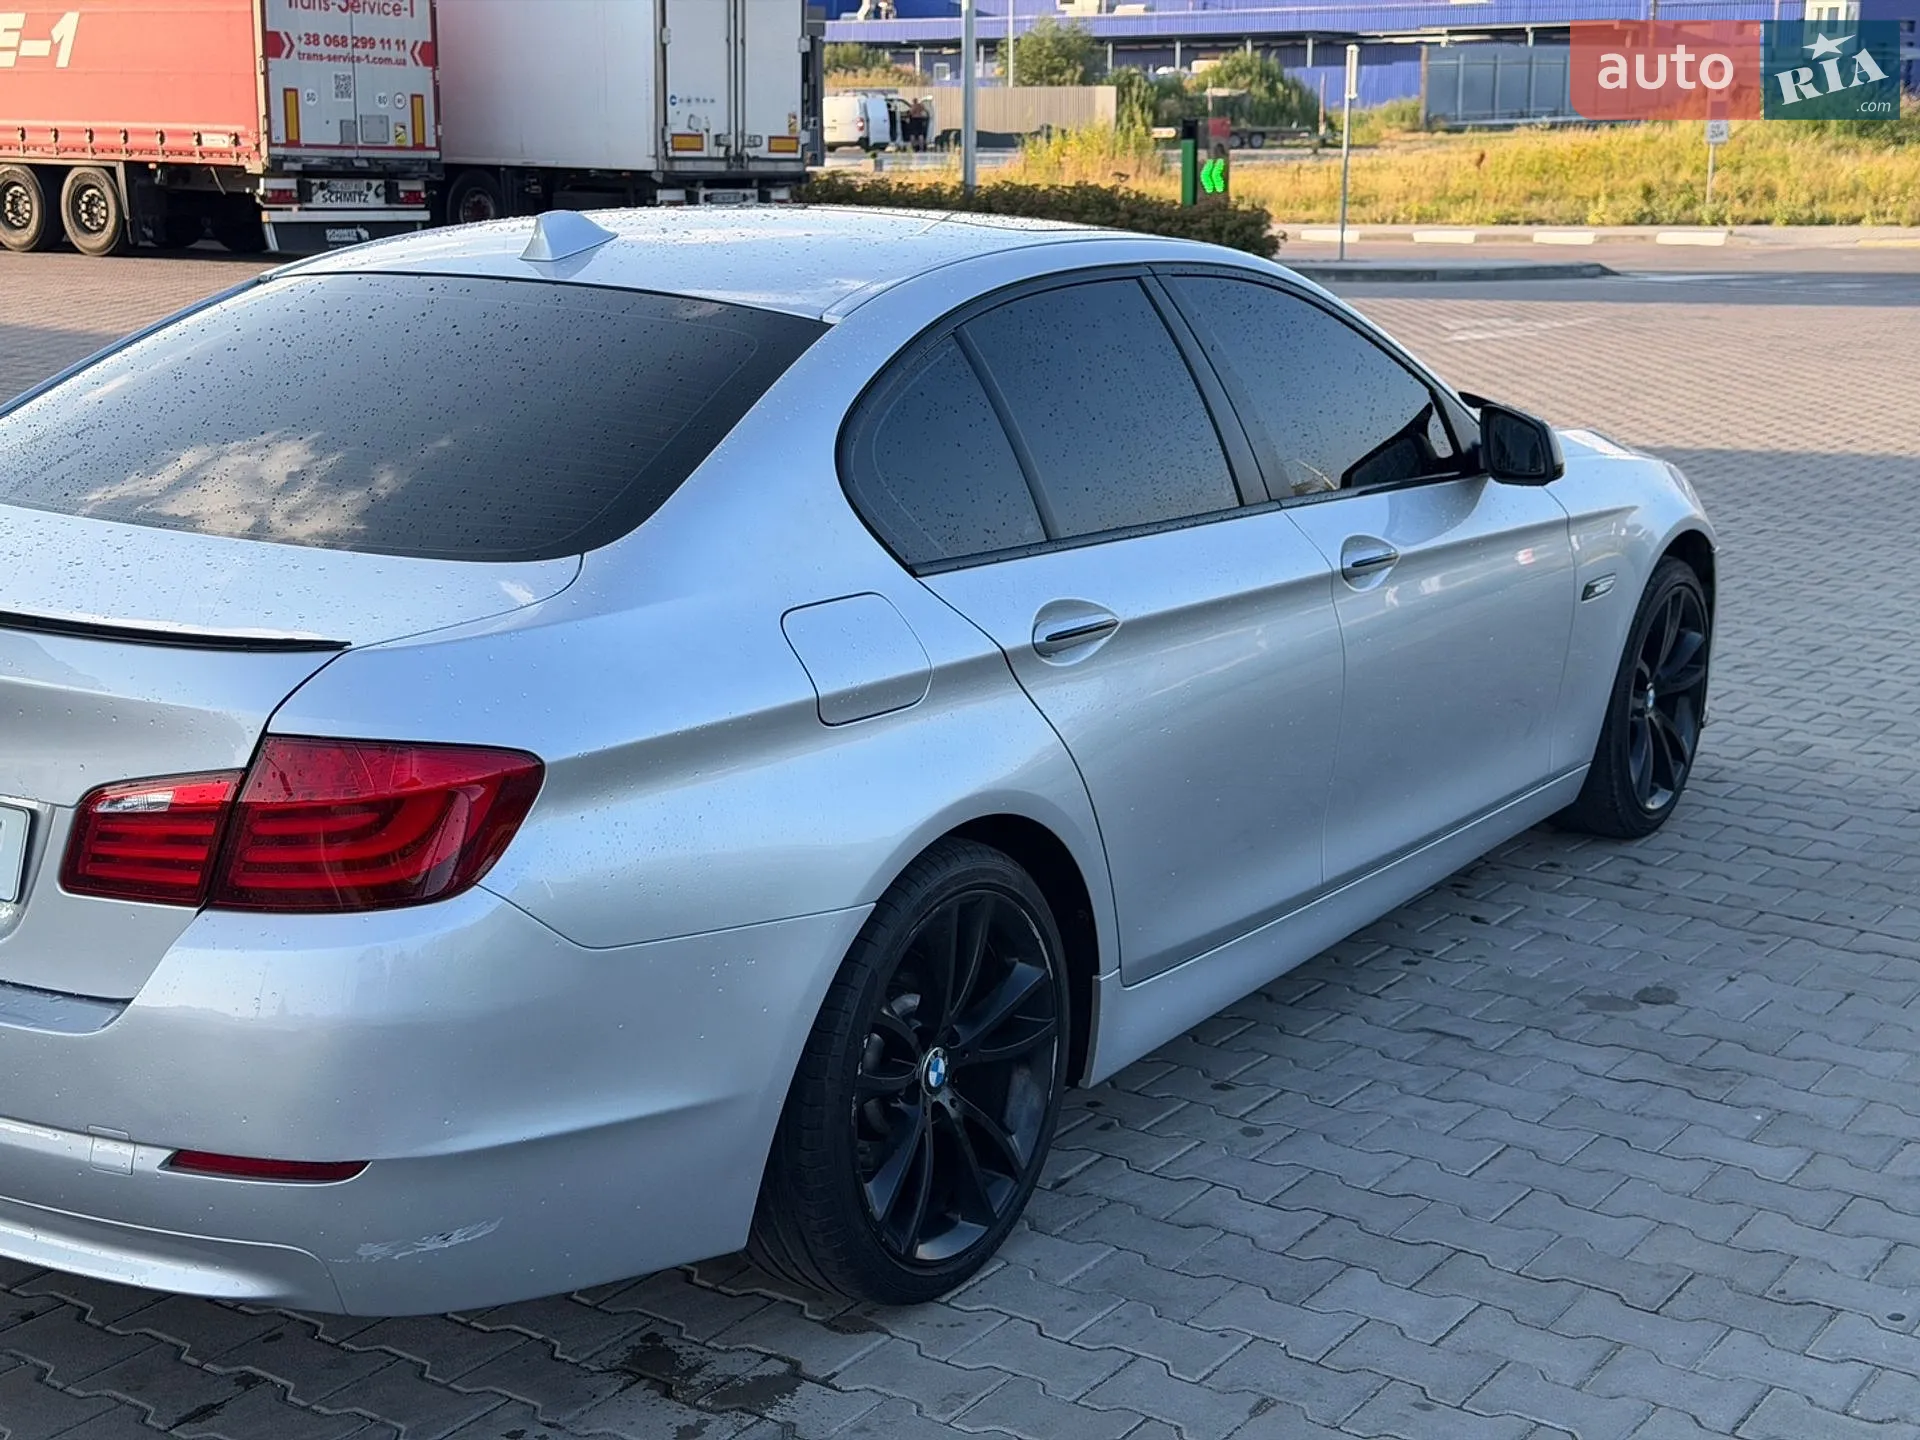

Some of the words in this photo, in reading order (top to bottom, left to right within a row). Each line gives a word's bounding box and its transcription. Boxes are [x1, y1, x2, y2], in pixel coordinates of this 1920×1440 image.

[297, 33, 320, 46] +38
[324, 34, 348, 48] 068
[352, 36, 376, 49] 299
[379, 38, 391, 50] 11
[395, 39, 406, 51] 11
[297, 51, 407, 66] trans-service-1.com.ua
[322, 191, 369, 203] SCHMITZ
